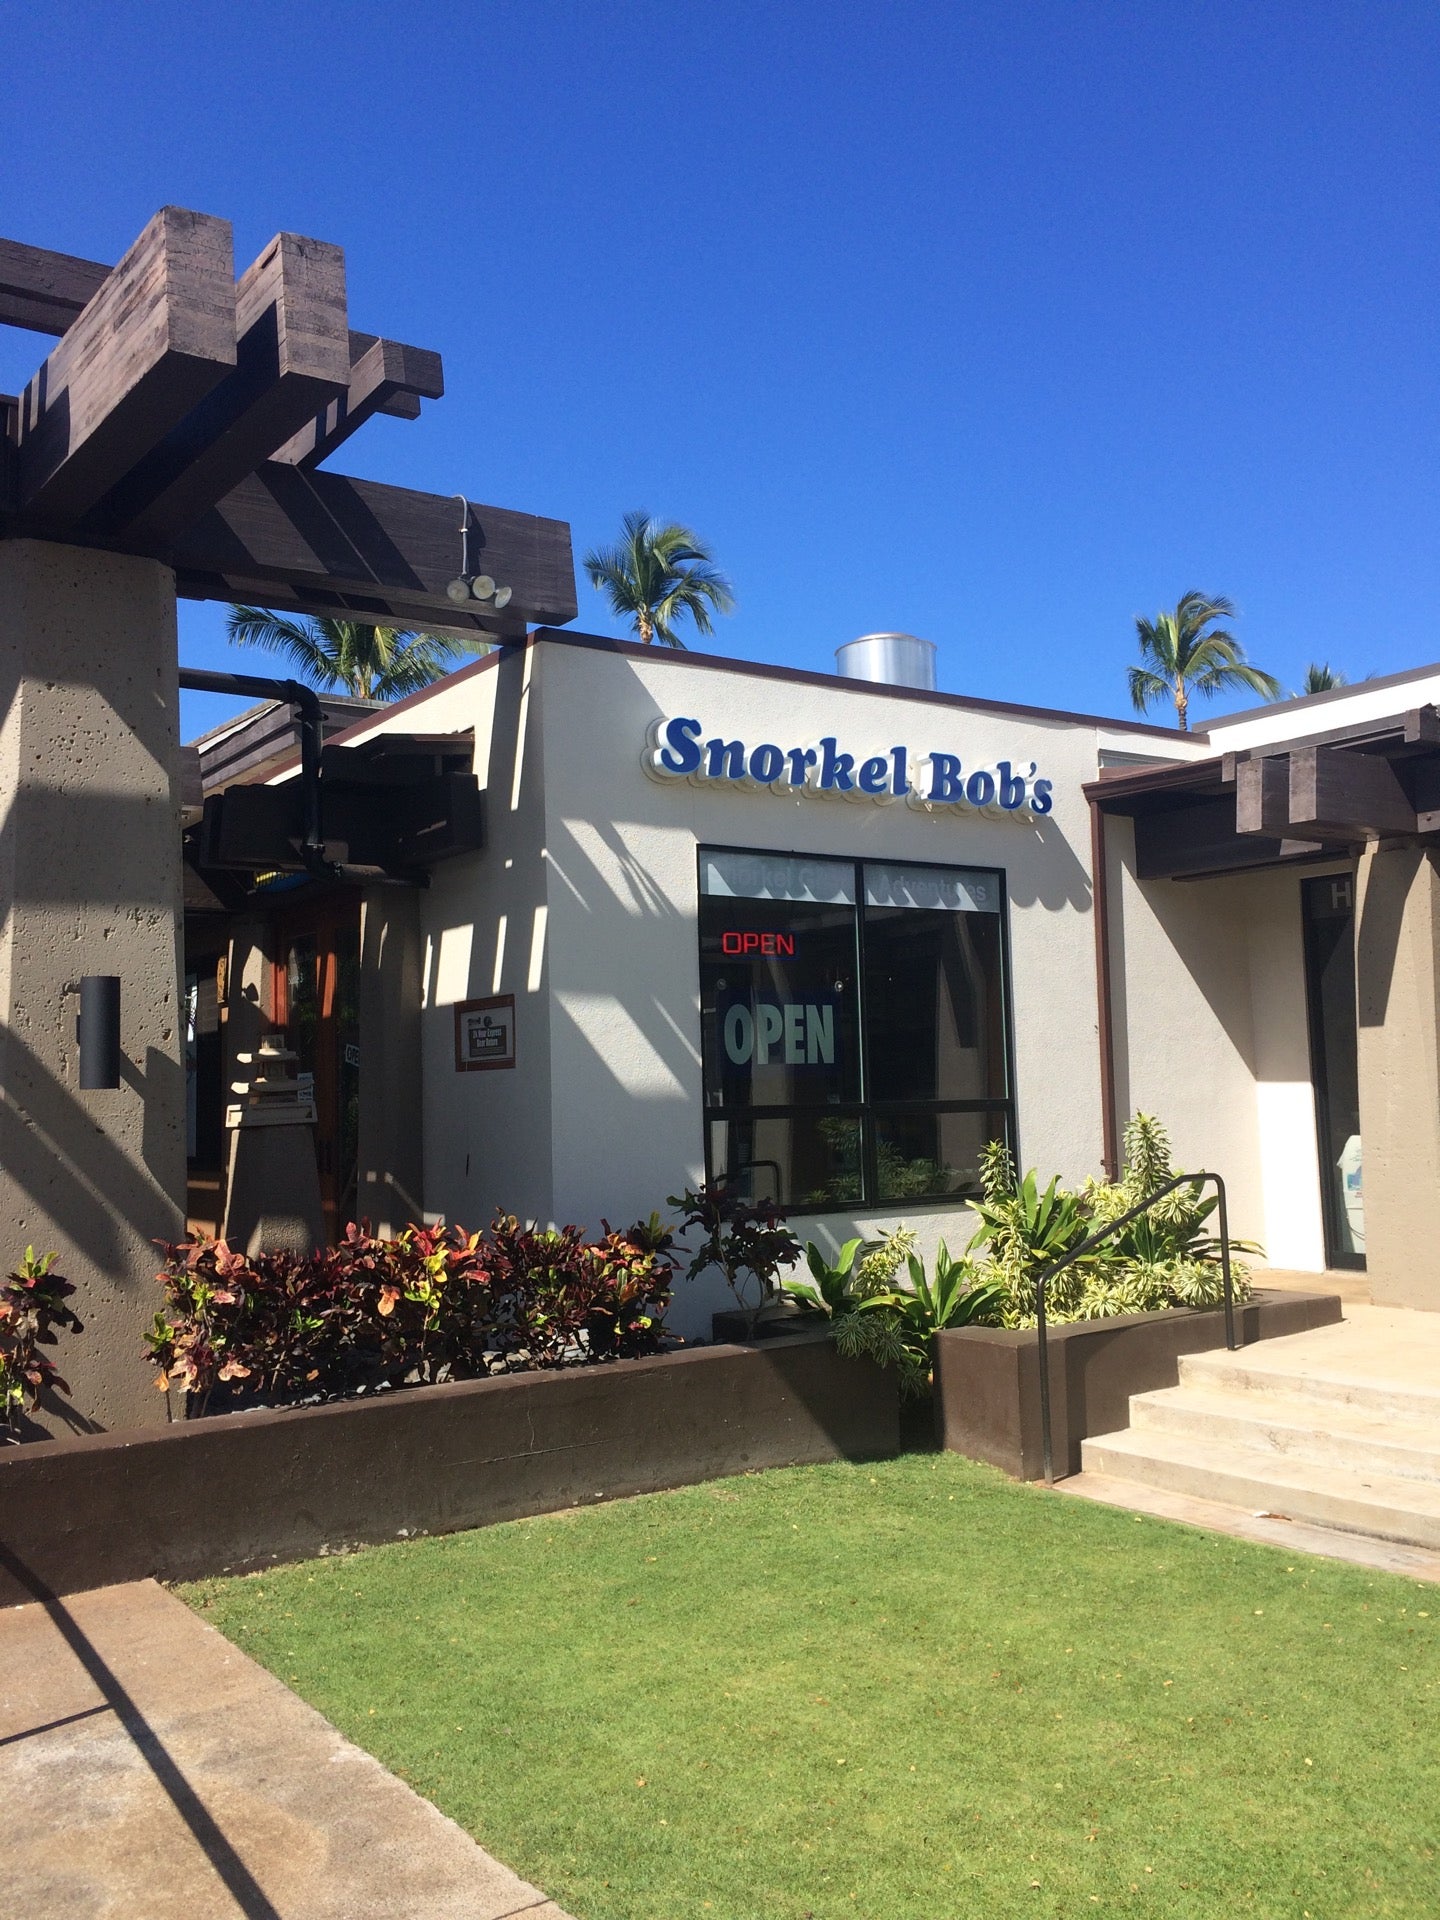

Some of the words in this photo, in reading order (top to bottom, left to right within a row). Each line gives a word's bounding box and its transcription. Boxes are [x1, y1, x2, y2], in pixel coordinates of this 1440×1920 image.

[660, 716, 912, 797] Snorkel
[926, 751, 1053, 815] Bob's
[877, 874, 987, 901] Adventues
[722, 932, 795, 955] OPEN
[724, 1003, 836, 1065] OPEN
[346, 1046, 360, 1066] OPE
